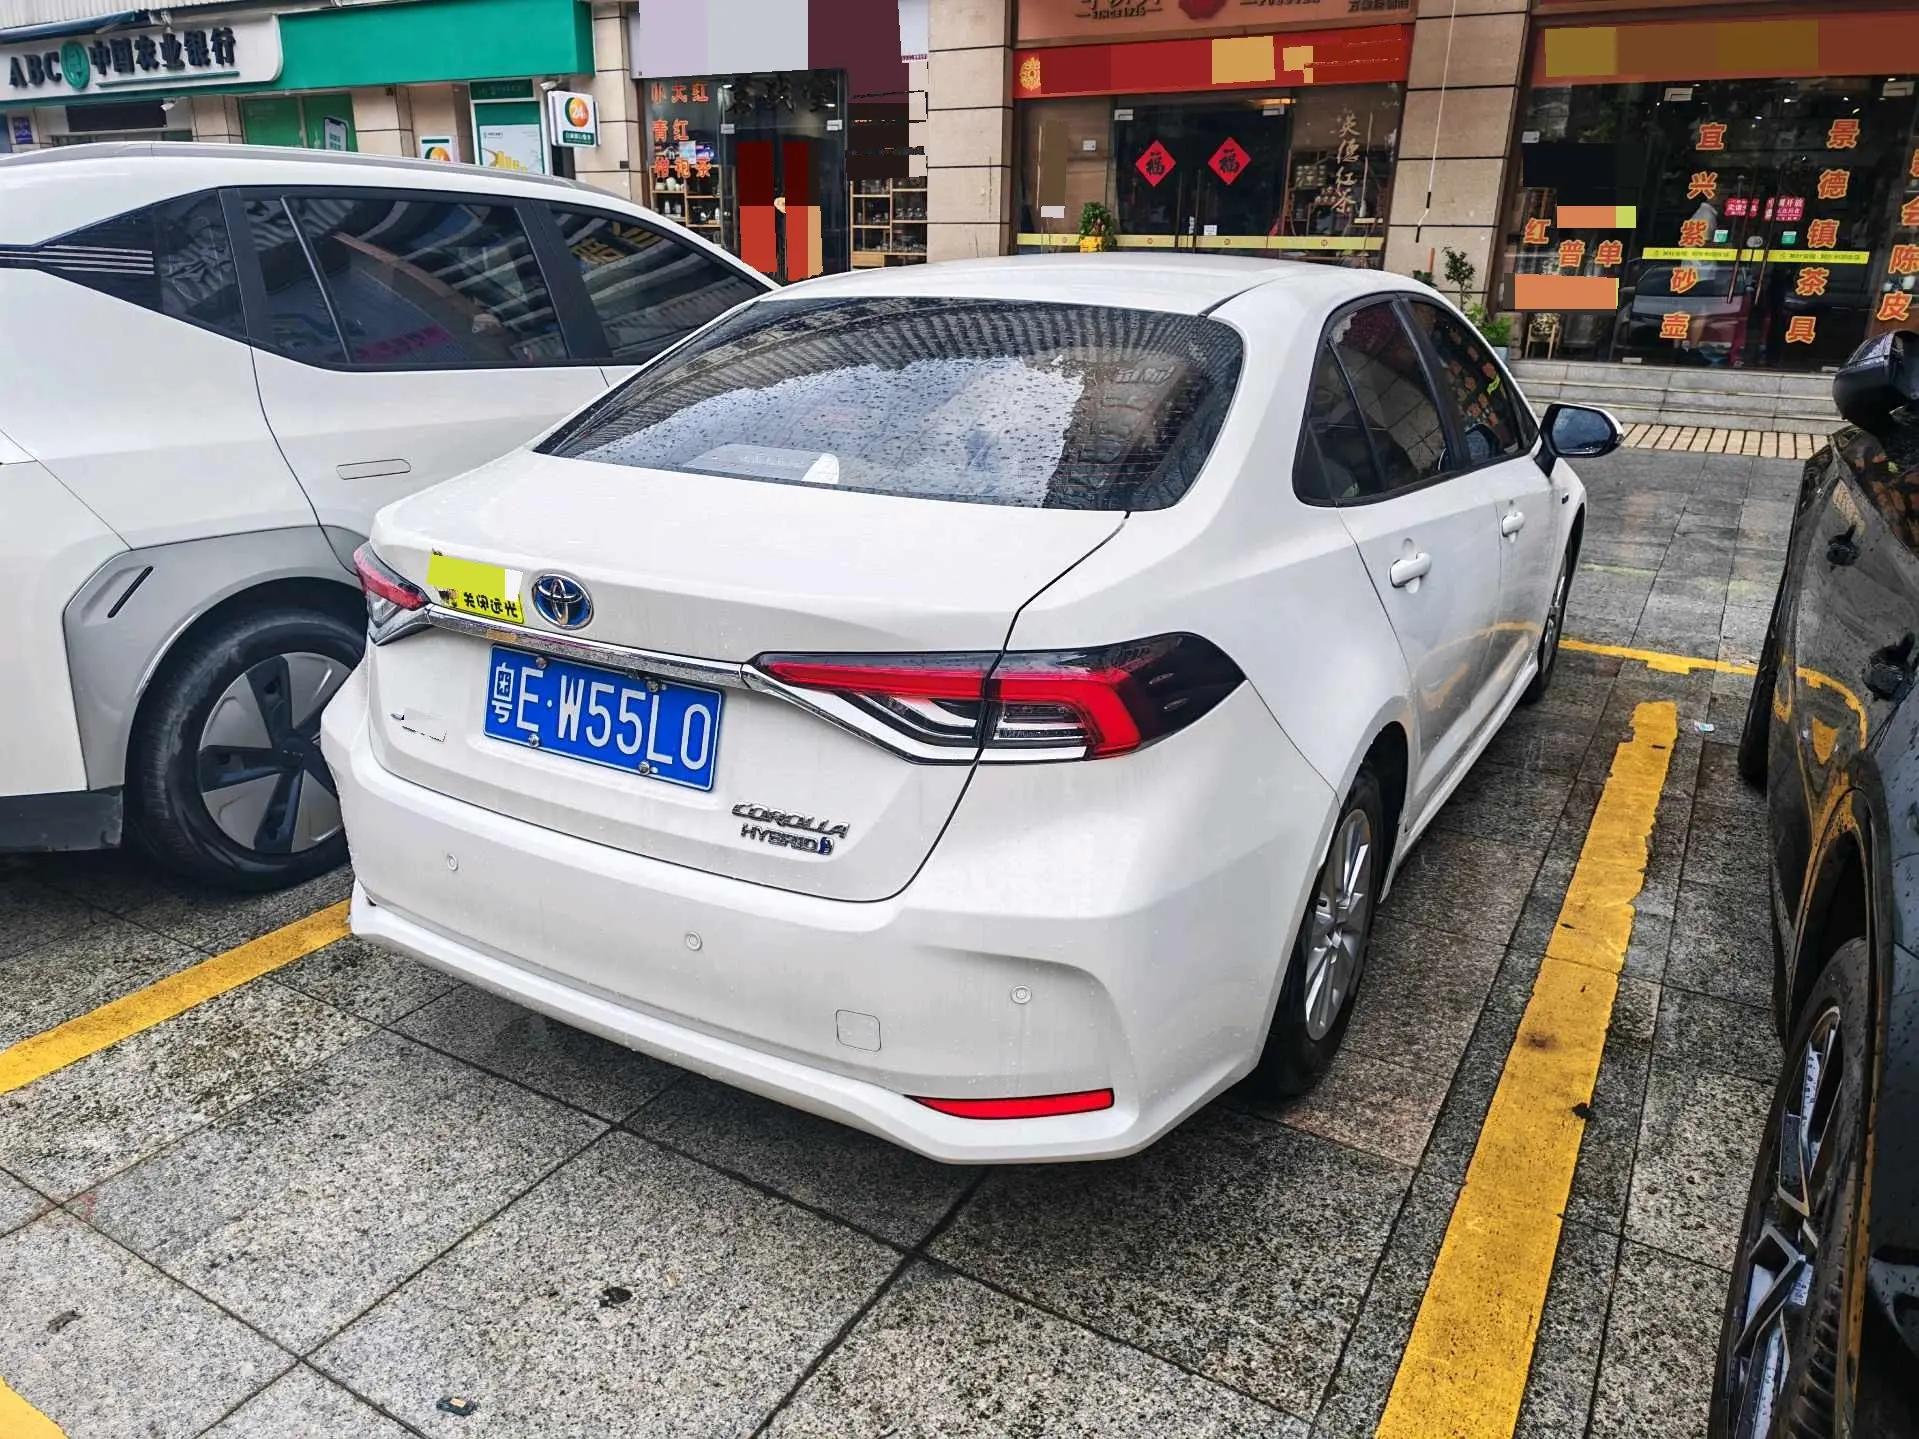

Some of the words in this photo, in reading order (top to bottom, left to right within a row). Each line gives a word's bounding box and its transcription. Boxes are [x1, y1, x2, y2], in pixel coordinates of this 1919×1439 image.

[9, 52, 62, 88] ABC
[88, 27, 237, 75] 中国农业银行
[1660, 122, 1727, 340] 宜兴紫砂壶
[1785, 118, 1860, 344] 景德镇茶具
[731, 803, 850, 839] COROLLA
[741, 823, 819, 854] HYBRID
